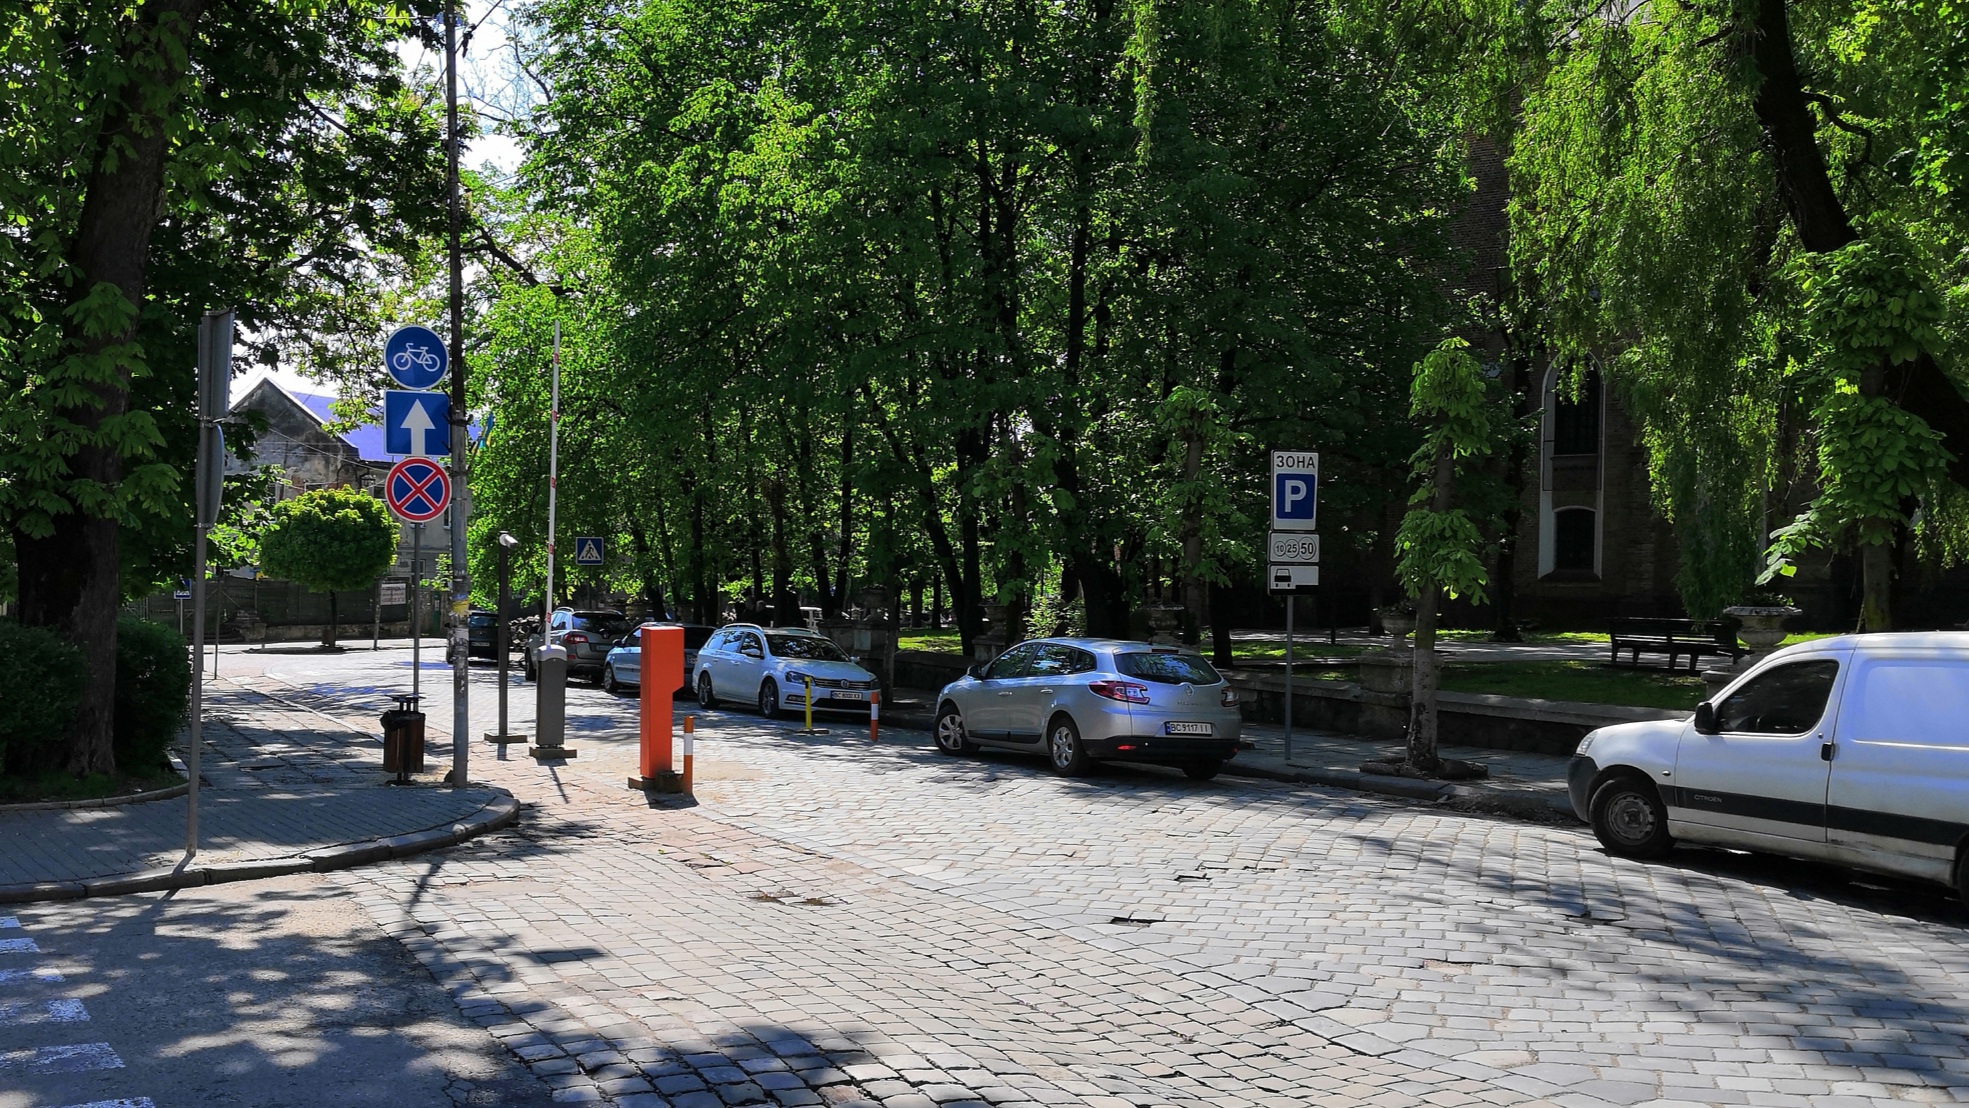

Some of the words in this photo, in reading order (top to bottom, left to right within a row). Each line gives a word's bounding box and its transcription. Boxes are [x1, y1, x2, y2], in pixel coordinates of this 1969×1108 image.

[1276, 455, 1316, 469] ЗОНА
[1284, 479, 1307, 513] P
[1275, 544, 1284, 553] 10
[1286, 543, 1298, 554] 25
[1300, 542, 1314, 555] 50
